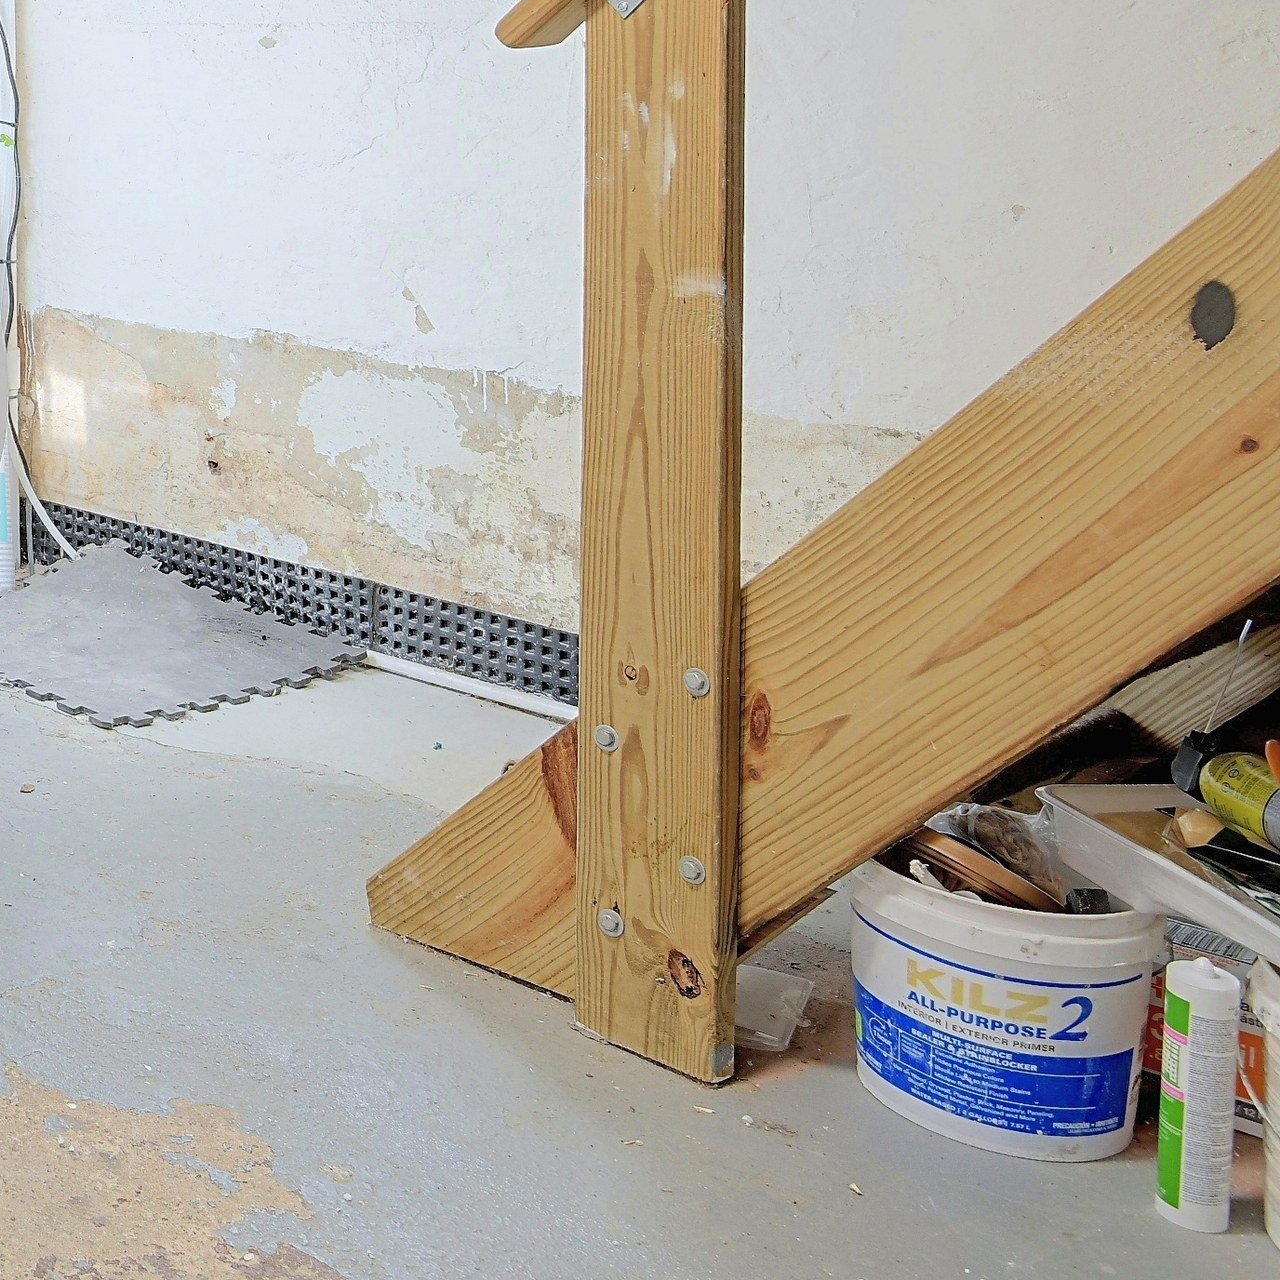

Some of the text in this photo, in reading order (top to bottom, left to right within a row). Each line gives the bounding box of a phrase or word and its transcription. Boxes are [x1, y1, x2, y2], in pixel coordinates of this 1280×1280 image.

[906, 957, 1053, 1025] KILZ
[897, 999, 943, 1027] INTERIOR
[951, 1023, 1009, 1047] EXTERIOR
[1012, 1039, 1056, 1053] PRIMER
[906, 989, 1048, 1040] ALL-PURPOSE
[1049, 995, 1094, 1042] 2
[911, 1028, 947, 1051] SEALER
[956, 1046, 1038, 1072] STAINBLOCKER
[931, 1029, 1013, 1061] MULTI-SURFACE
[953, 1063, 981, 1077] Previous
[982, 1073, 1004, 1083] Colors
[982, 1078, 1009, 1092] Medium
[1010, 1086, 1031, 1096] Stains
[911, 1086, 956, 1111] WATER-BASED
[989, 1089, 1009, 1099] Finish
[1005, 1112, 1017, 1120] and
[1018, 1114, 1036, 1122] More
